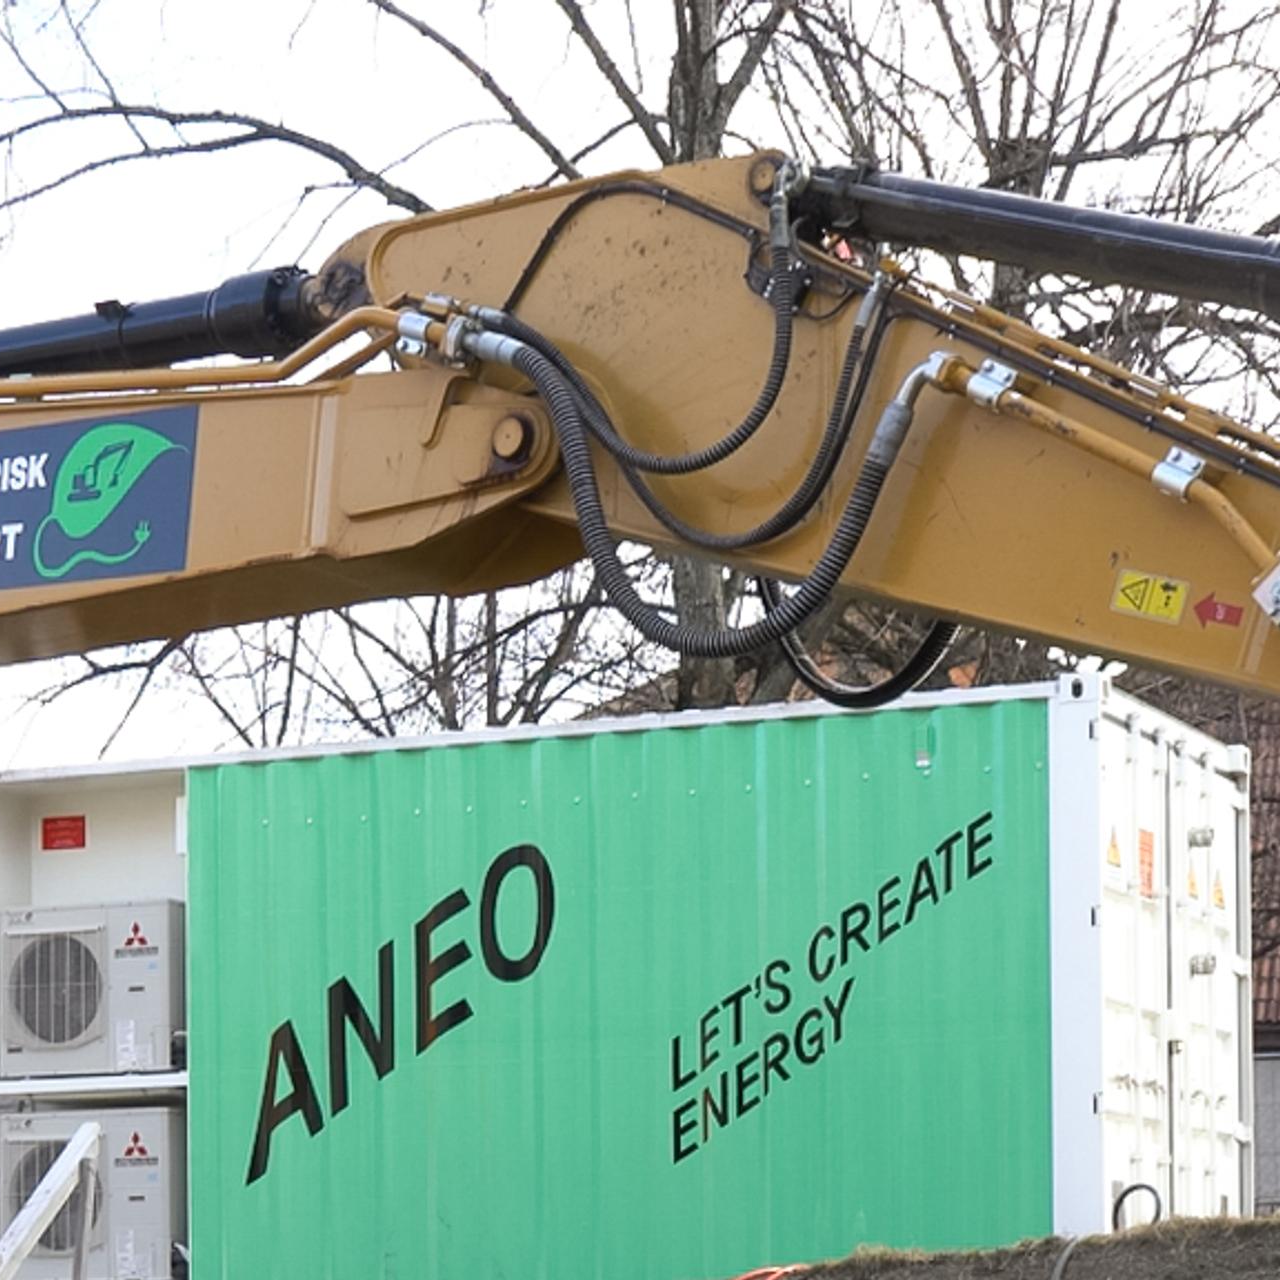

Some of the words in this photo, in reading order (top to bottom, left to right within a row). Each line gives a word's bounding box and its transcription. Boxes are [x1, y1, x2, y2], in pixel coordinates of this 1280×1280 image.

[245, 843, 555, 1186] ANEO
[672, 960, 793, 1092] LET'S
[808, 811, 994, 983] CREATE
[673, 977, 855, 1164] ENERGY
